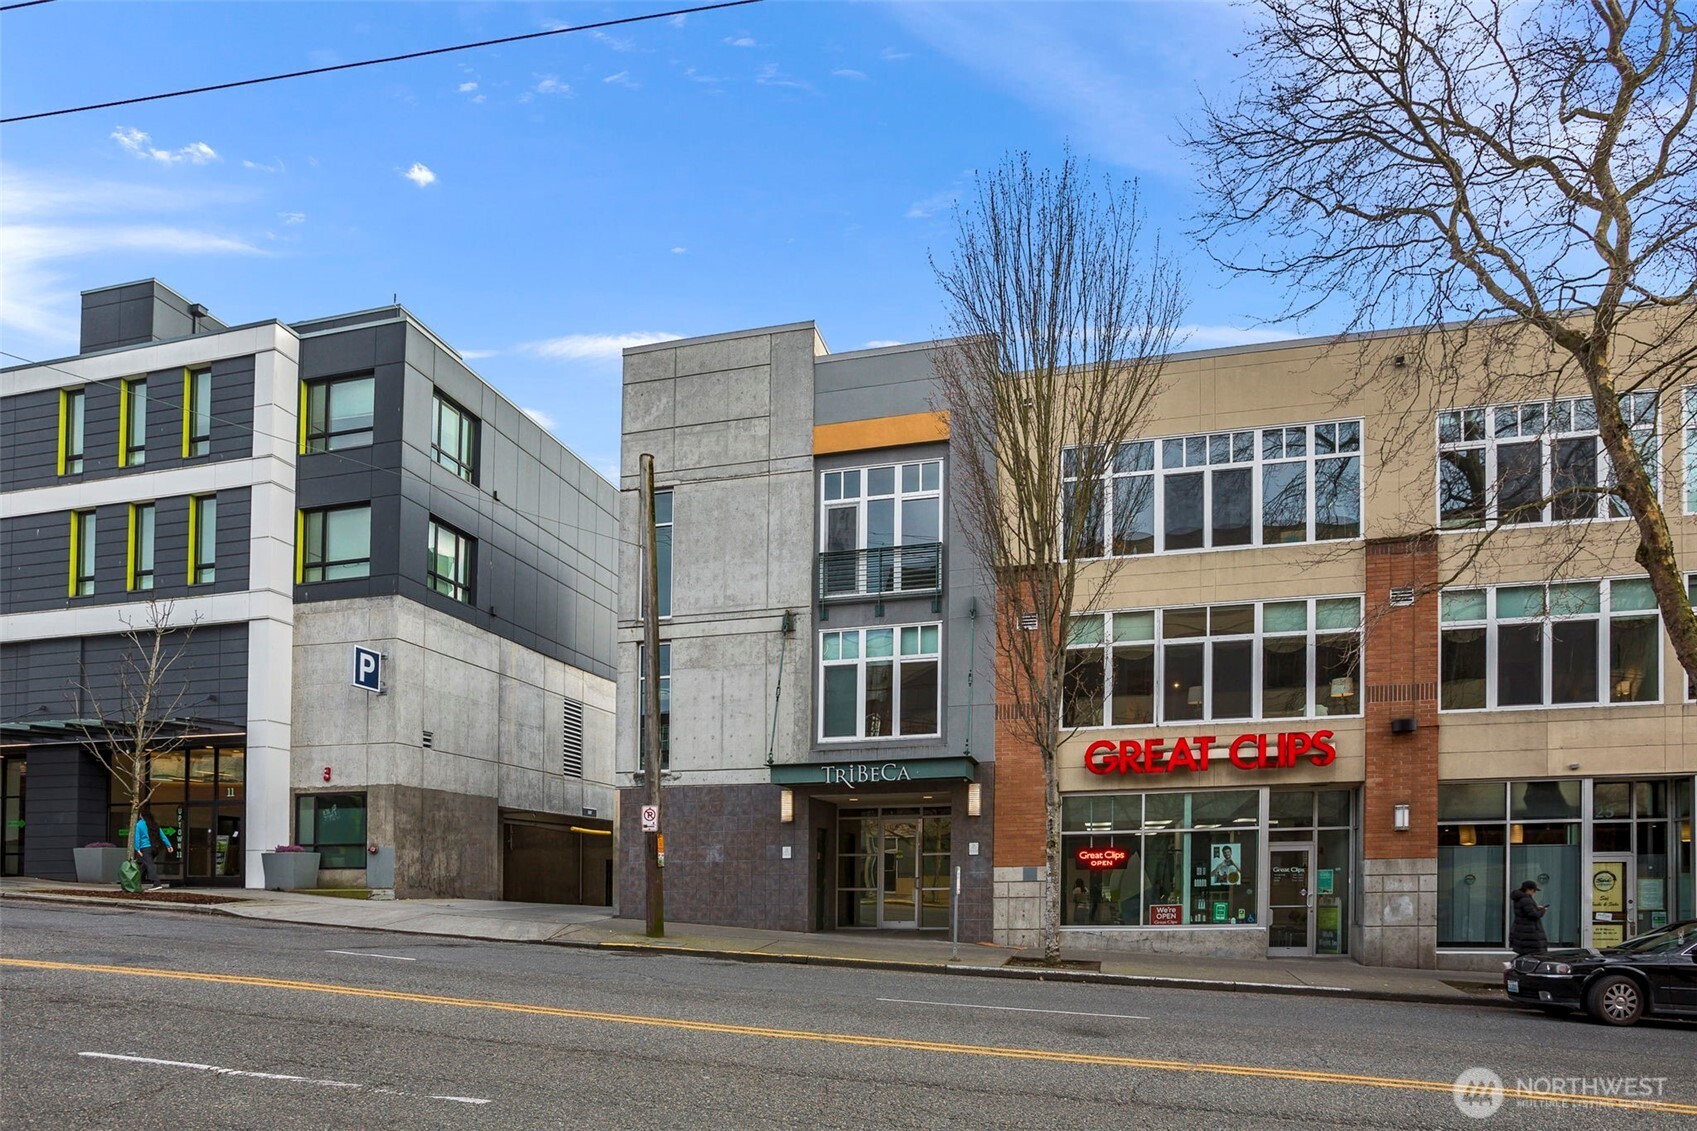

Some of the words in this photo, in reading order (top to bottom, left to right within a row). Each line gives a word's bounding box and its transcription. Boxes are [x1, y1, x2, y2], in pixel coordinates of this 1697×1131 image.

[359, 652, 375, 682] P
[1084, 736, 1217, 775] GREAT
[1229, 730, 1337, 770] CLIPS
[226, 787, 235, 797] 11
[1079, 851, 1104, 860] Great
[1104, 850, 1125, 861] Clips
[1290, 866, 1305, 874] Clips
[1156, 906, 1177, 914] We're
